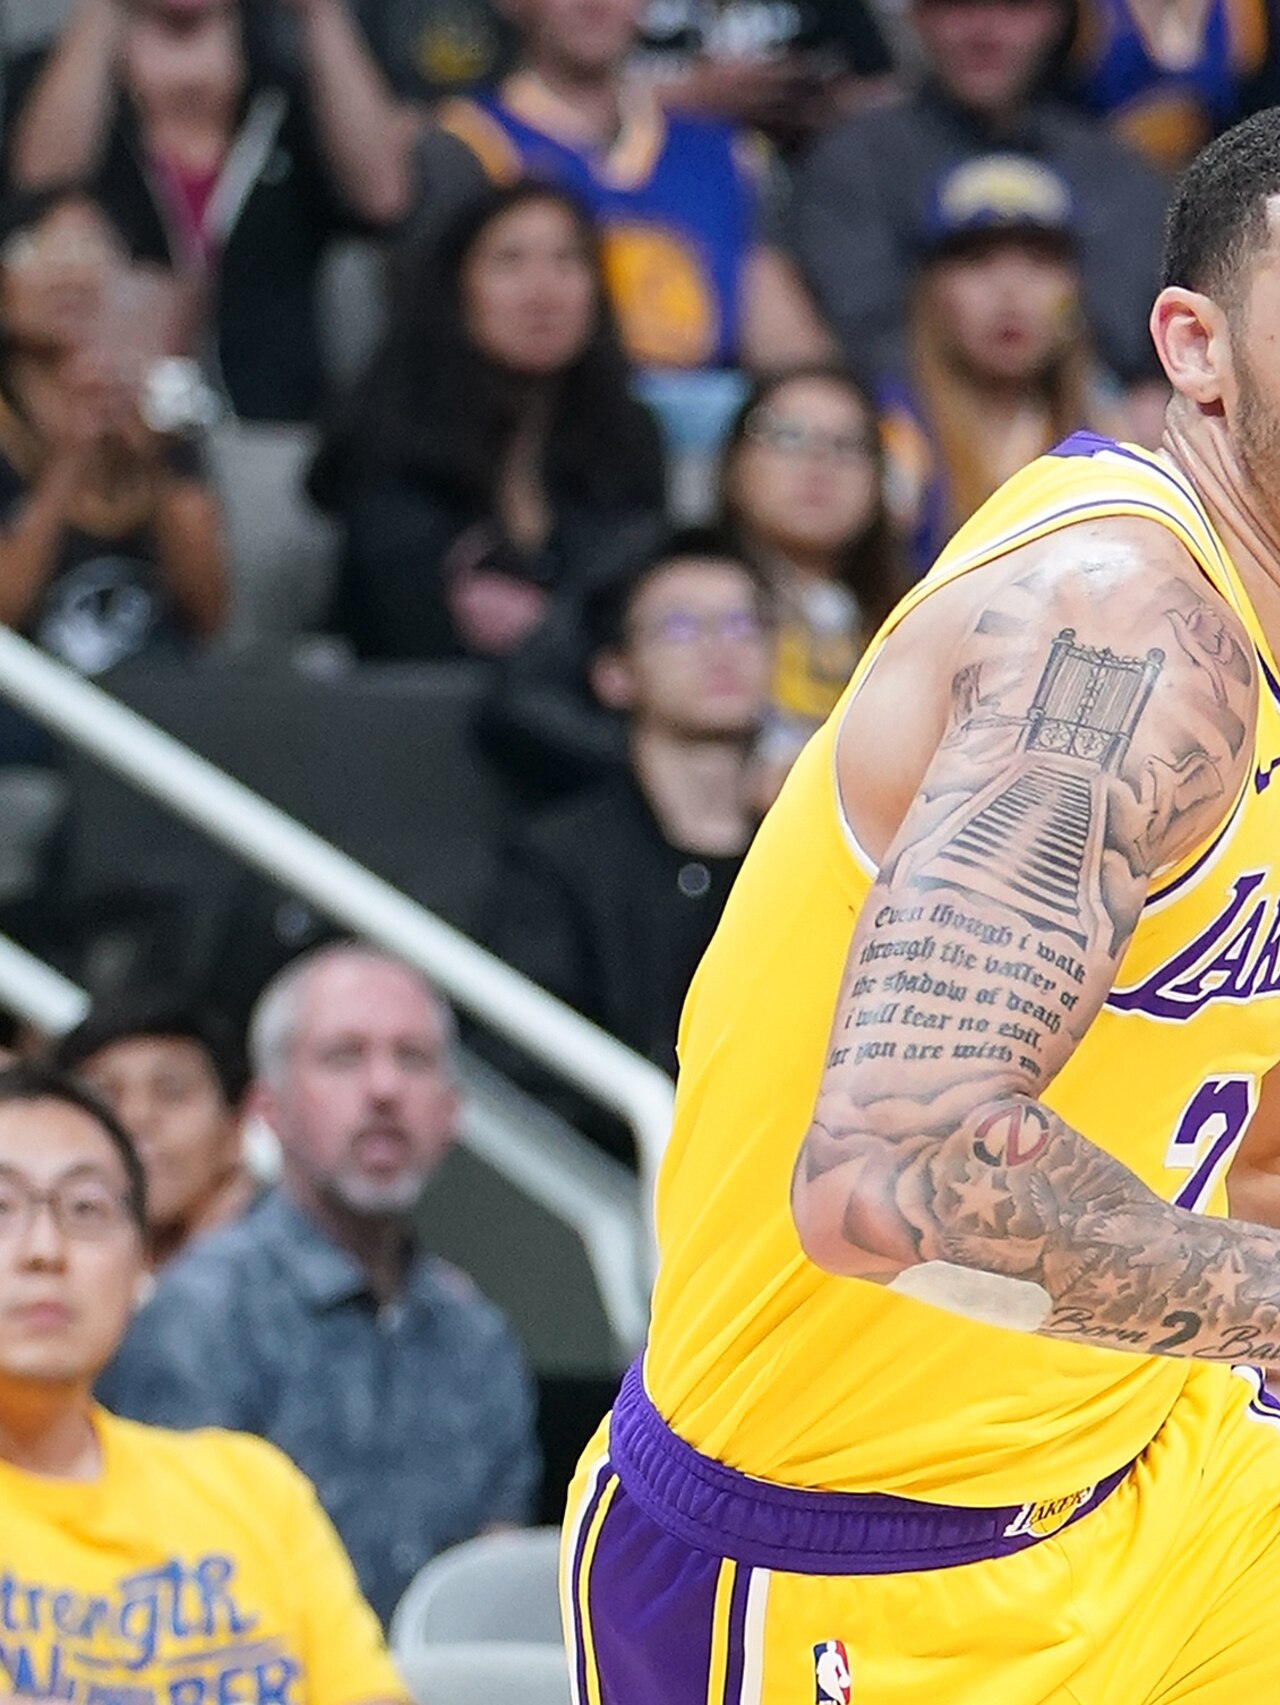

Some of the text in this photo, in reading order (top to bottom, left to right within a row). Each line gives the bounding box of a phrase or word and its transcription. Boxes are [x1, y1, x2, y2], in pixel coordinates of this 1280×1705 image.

[860, 935, 1080, 1012] through the valley of
[874, 904, 923, 929] Even
[929, 903, 1013, 947] though
[1036, 940, 1086, 985] walk
[851, 969, 1062, 1035] the shadow of death
[900, 1004, 953, 1032] fear
[957, 1016, 989, 1033] no
[854, 1041, 898, 1066] you
[902, 1043, 944, 1061] are
[951, 1042, 1013, 1063] with
[1050, 1306, 1150, 1345] Born
[1147, 1310, 1202, 1358] 2
